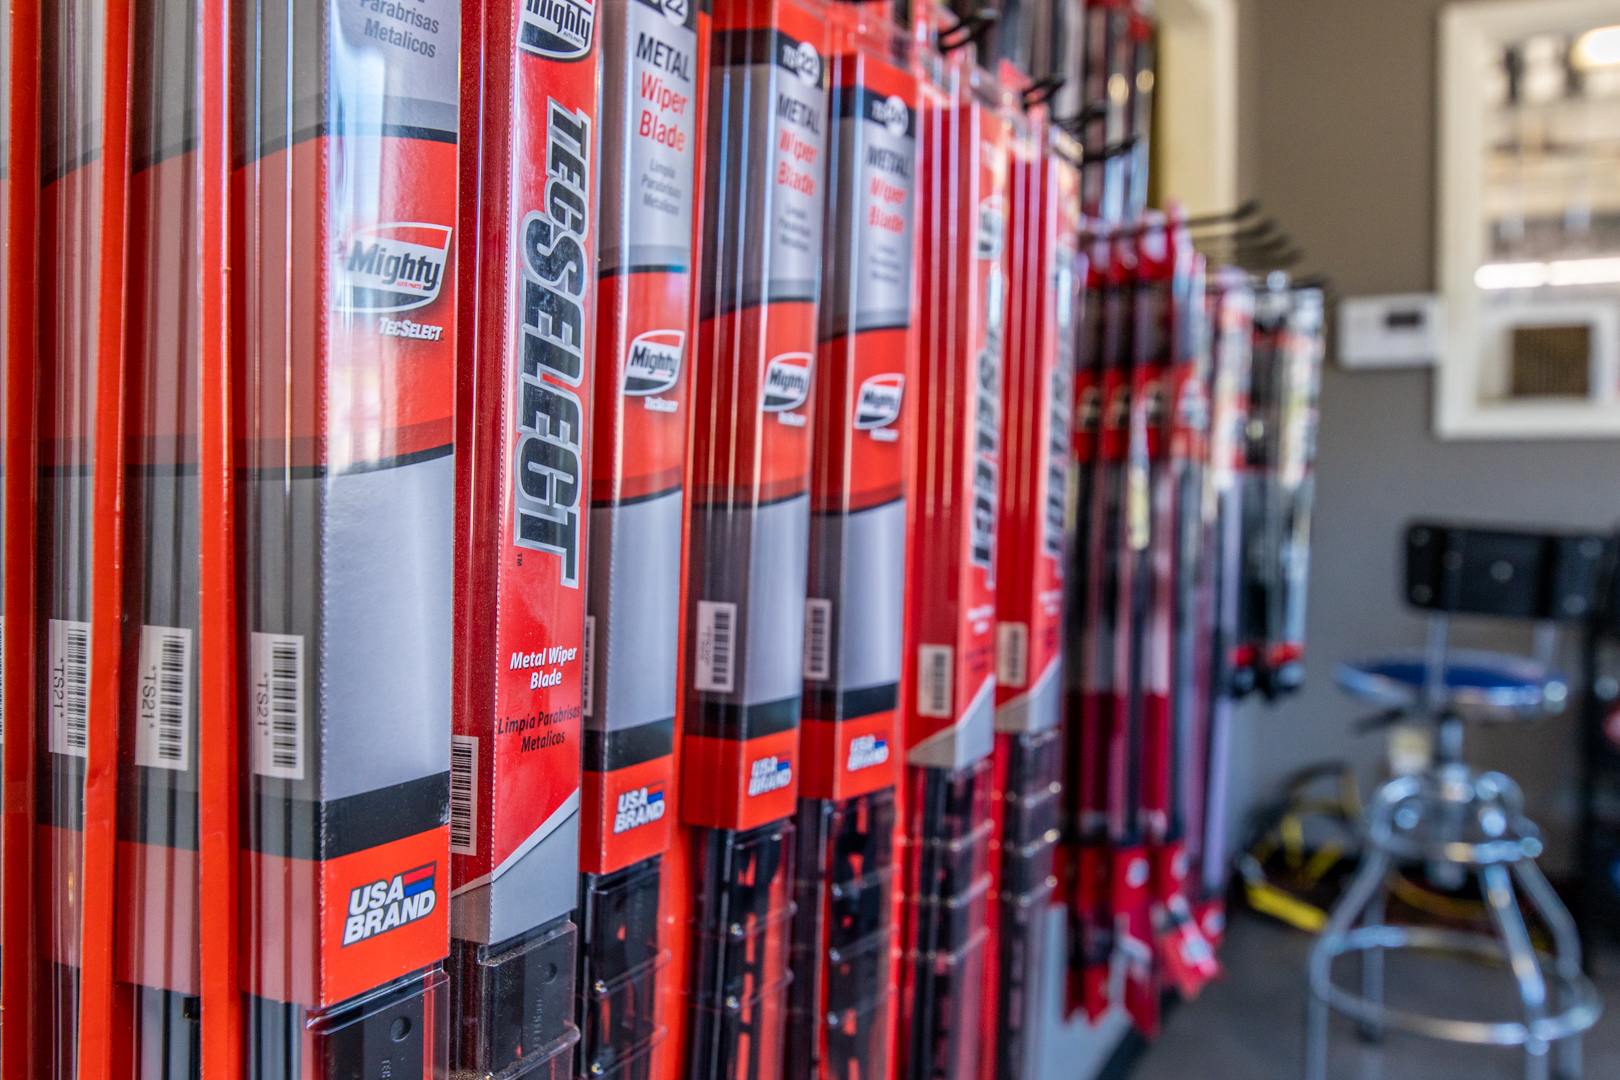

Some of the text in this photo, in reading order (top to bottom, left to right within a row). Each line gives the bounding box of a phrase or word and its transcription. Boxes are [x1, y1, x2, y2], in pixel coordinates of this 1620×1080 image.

[364, 18, 437, 58] Metalicos
[636, 31, 690, 82] METAL
[641, 71, 687, 115] Wiper
[639, 110, 686, 152] Blade
[776, 93, 821, 135] METAL
[778, 126, 819, 165] Wiper
[347, 239, 441, 291] Mighty
[513, 95, 591, 589] TECSELECT
[631, 345, 678, 378] Mighty
[510, 646, 577, 671] Metal Wiper
[530, 668, 562, 690] Blade
[498, 705, 580, 735] Limpia Parabrisas
[521, 730, 565, 753] Metalicos
[614, 799, 666, 835] BRAND
[617, 786, 648, 814] USA
[348, 874, 405, 916] USA
[342, 889, 437, 947] BRAND
